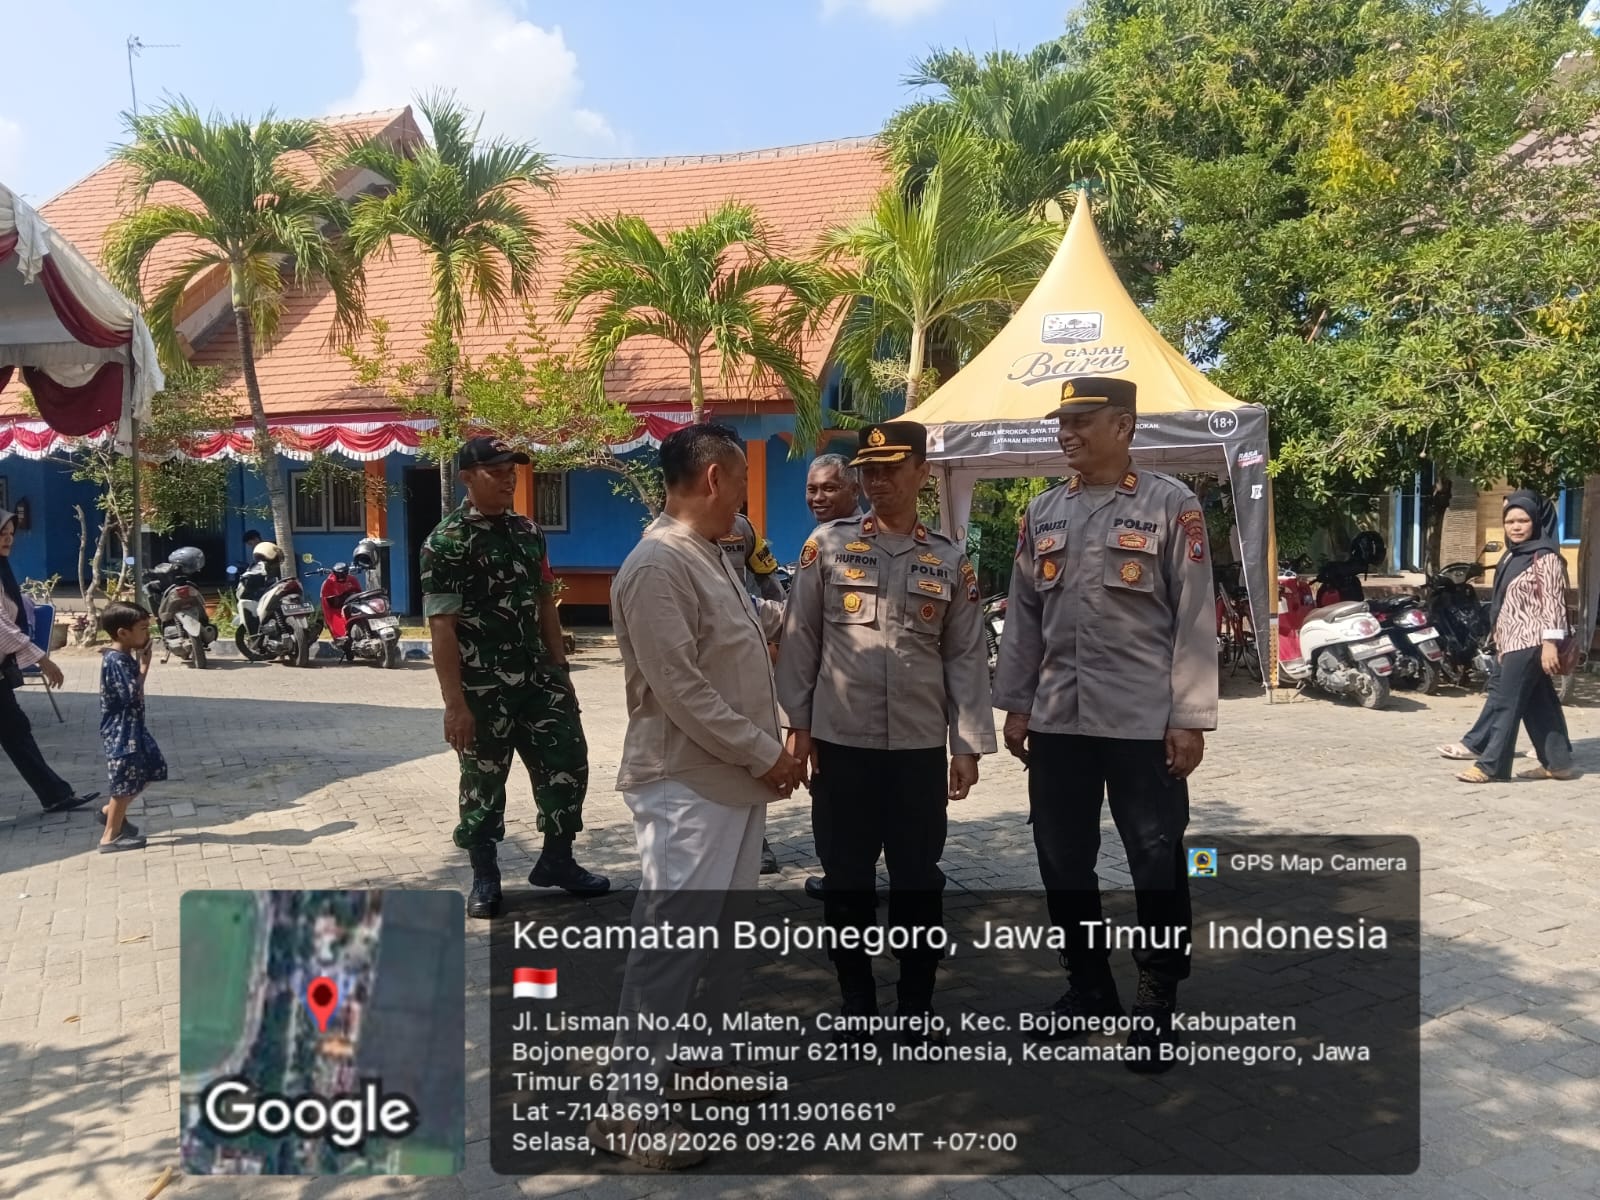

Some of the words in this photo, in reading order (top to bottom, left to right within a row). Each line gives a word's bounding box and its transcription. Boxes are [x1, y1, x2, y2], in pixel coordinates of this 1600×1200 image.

[1064, 346, 1125, 358] GAJAH
[1007, 351, 1130, 387] Baru
[1212, 416, 1234, 428] 18+
[1113, 517, 1158, 533] POLRI
[834, 554, 877, 566] HUFRON
[910, 564, 948, 579] POLRI
